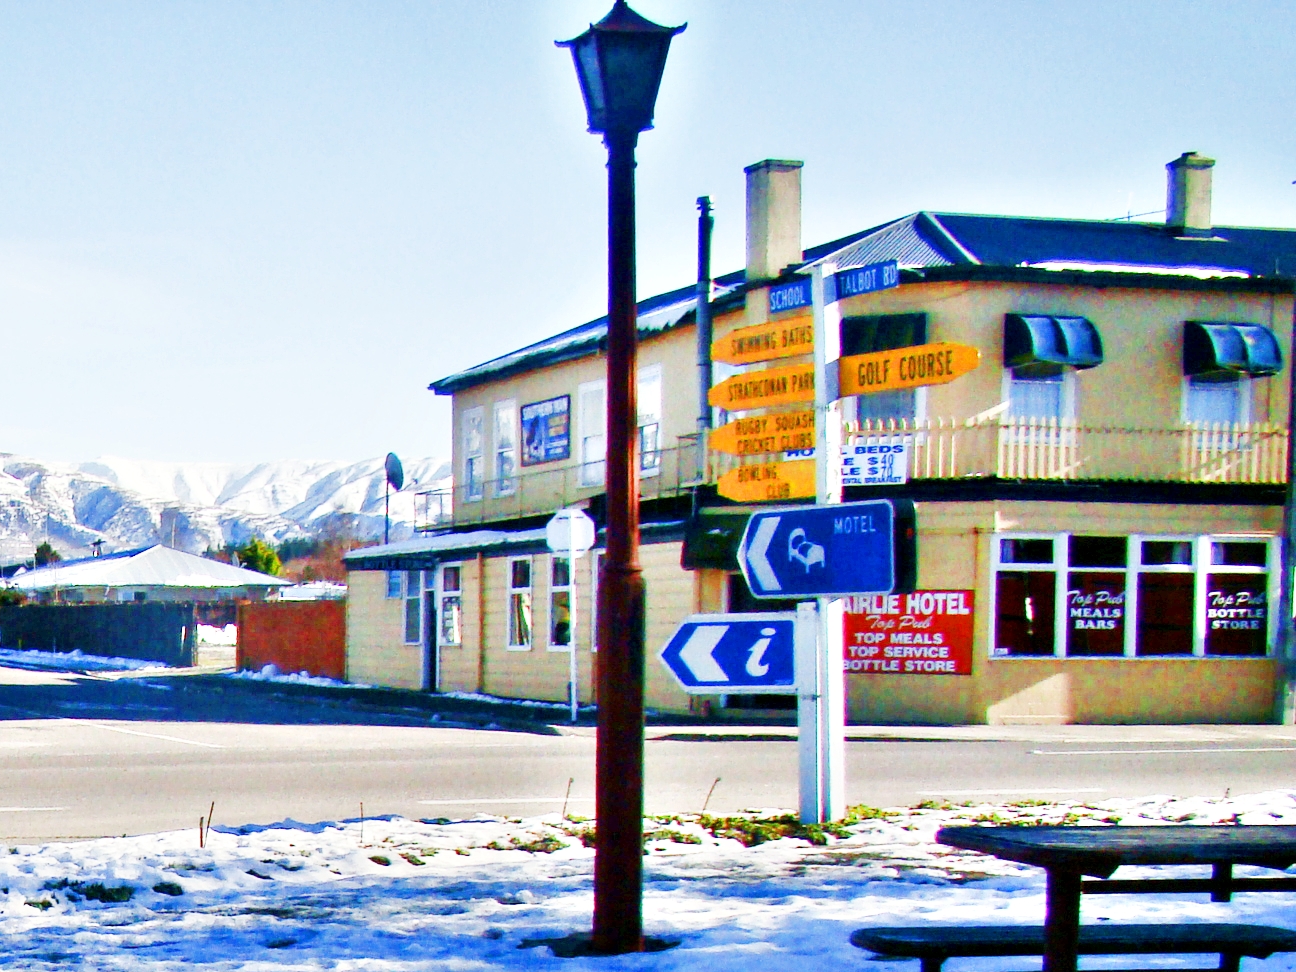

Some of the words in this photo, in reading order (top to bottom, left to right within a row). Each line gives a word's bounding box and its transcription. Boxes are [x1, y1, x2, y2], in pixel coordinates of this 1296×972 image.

[840, 269, 877, 293] TALBOT
[769, 287, 806, 311] SCHOOL
[731, 330, 777, 356] SWIMMING
[782, 325, 813, 346] BATHS
[857, 359, 891, 387] GOLF
[899, 350, 954, 381] COURSE
[792, 371, 815, 393] PARK
[735, 417, 767, 437] RUGBY
[775, 413, 815, 430] SQUASH
[736, 436, 777, 455] CRICKET
[781, 431, 813, 451] CLUBS
[855, 445, 904, 454] BEDS
[738, 465, 777, 483] BOWLING
[766, 483, 790, 500] CLUB
[834, 516, 876, 534] MOTEL
[843, 594, 900, 614] AIRLIE
[906, 593, 970, 615] HOTEL
[1067, 590, 1094, 607] Top
[1095, 591, 1125, 605] Pub
[1208, 591, 1235, 608] Top
[1070, 608, 1122, 618] MEALS
[1207, 608, 1264, 619] BOTTLE
[866, 615, 894, 629] Top
[898, 615, 933, 629] Pub
[1075, 620, 1116, 630] BARS
[1211, 620, 1260, 630] STORE
[855, 632, 885, 644] TOP
[891, 633, 943, 644] MEALS
[849, 646, 879, 657] TOP
[884, 646, 949, 658] SERVICE
[843, 660, 901, 671] BOTTLE
[905, 660, 956, 672] STORE
